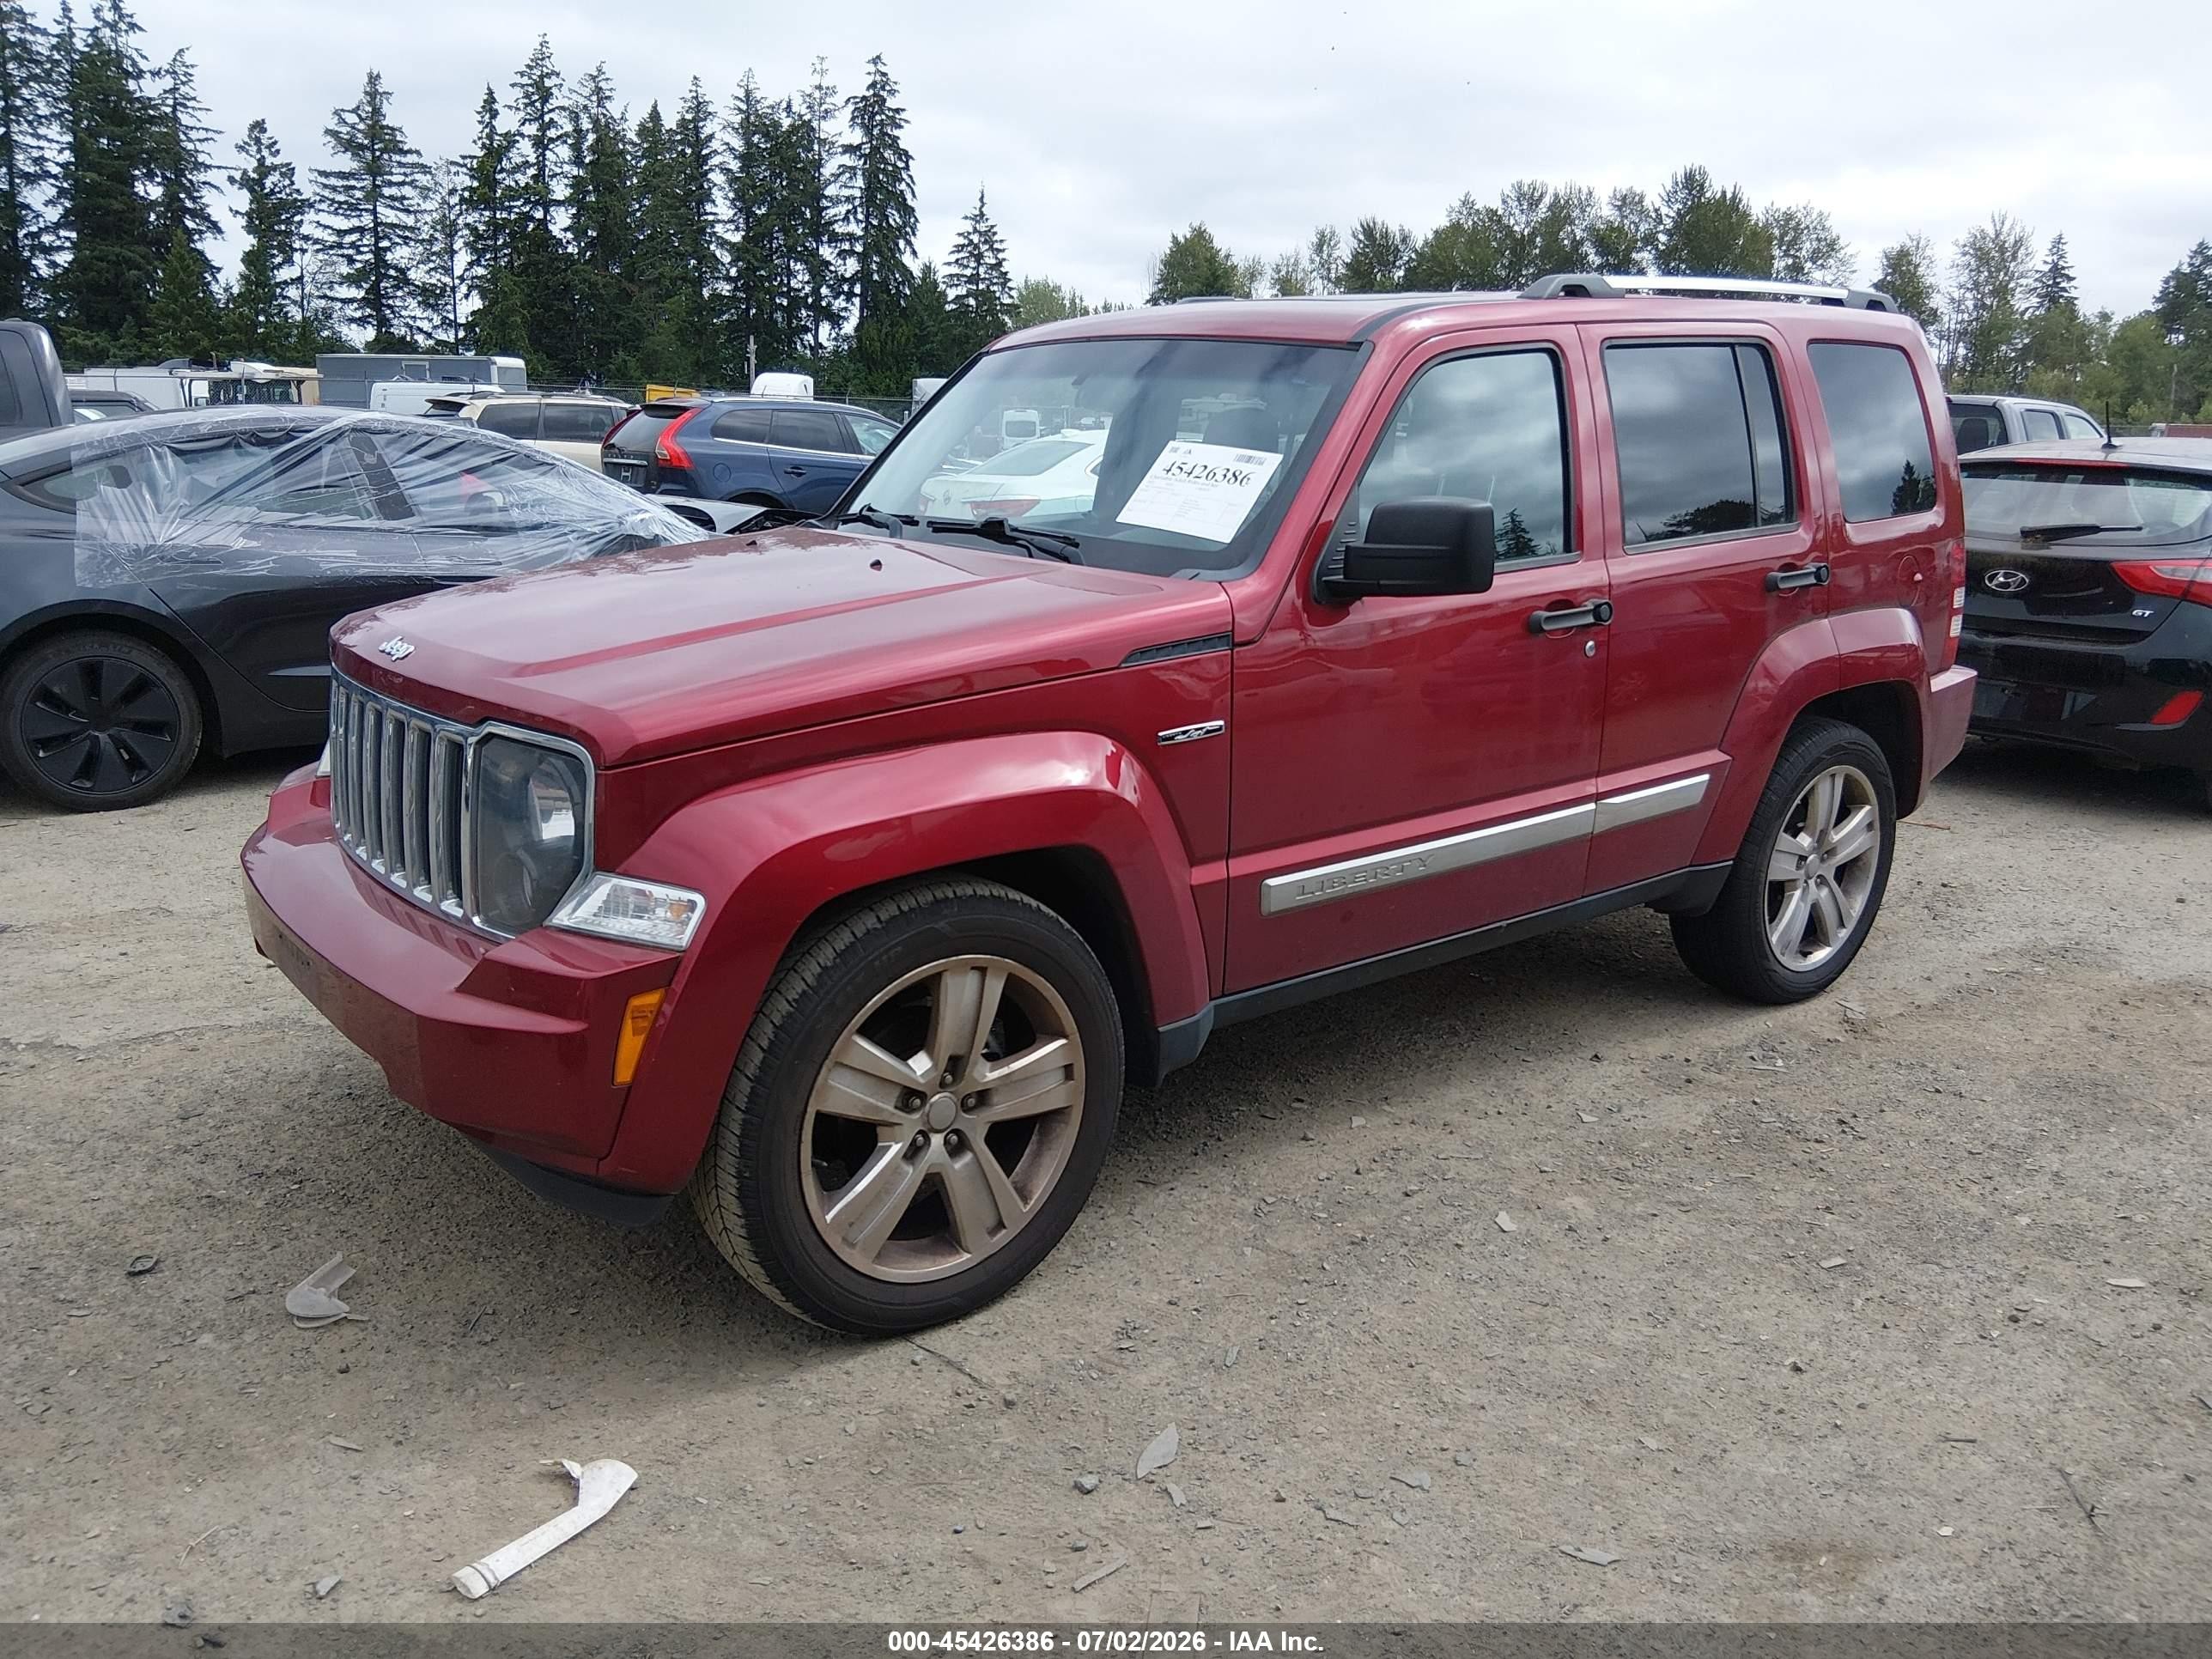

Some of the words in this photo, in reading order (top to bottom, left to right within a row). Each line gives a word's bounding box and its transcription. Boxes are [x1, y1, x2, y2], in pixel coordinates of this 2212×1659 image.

[1162, 460, 1256, 488] 45426386
[2131, 609, 2154, 619] GT
[1295, 854, 1436, 900] LIBERTY
